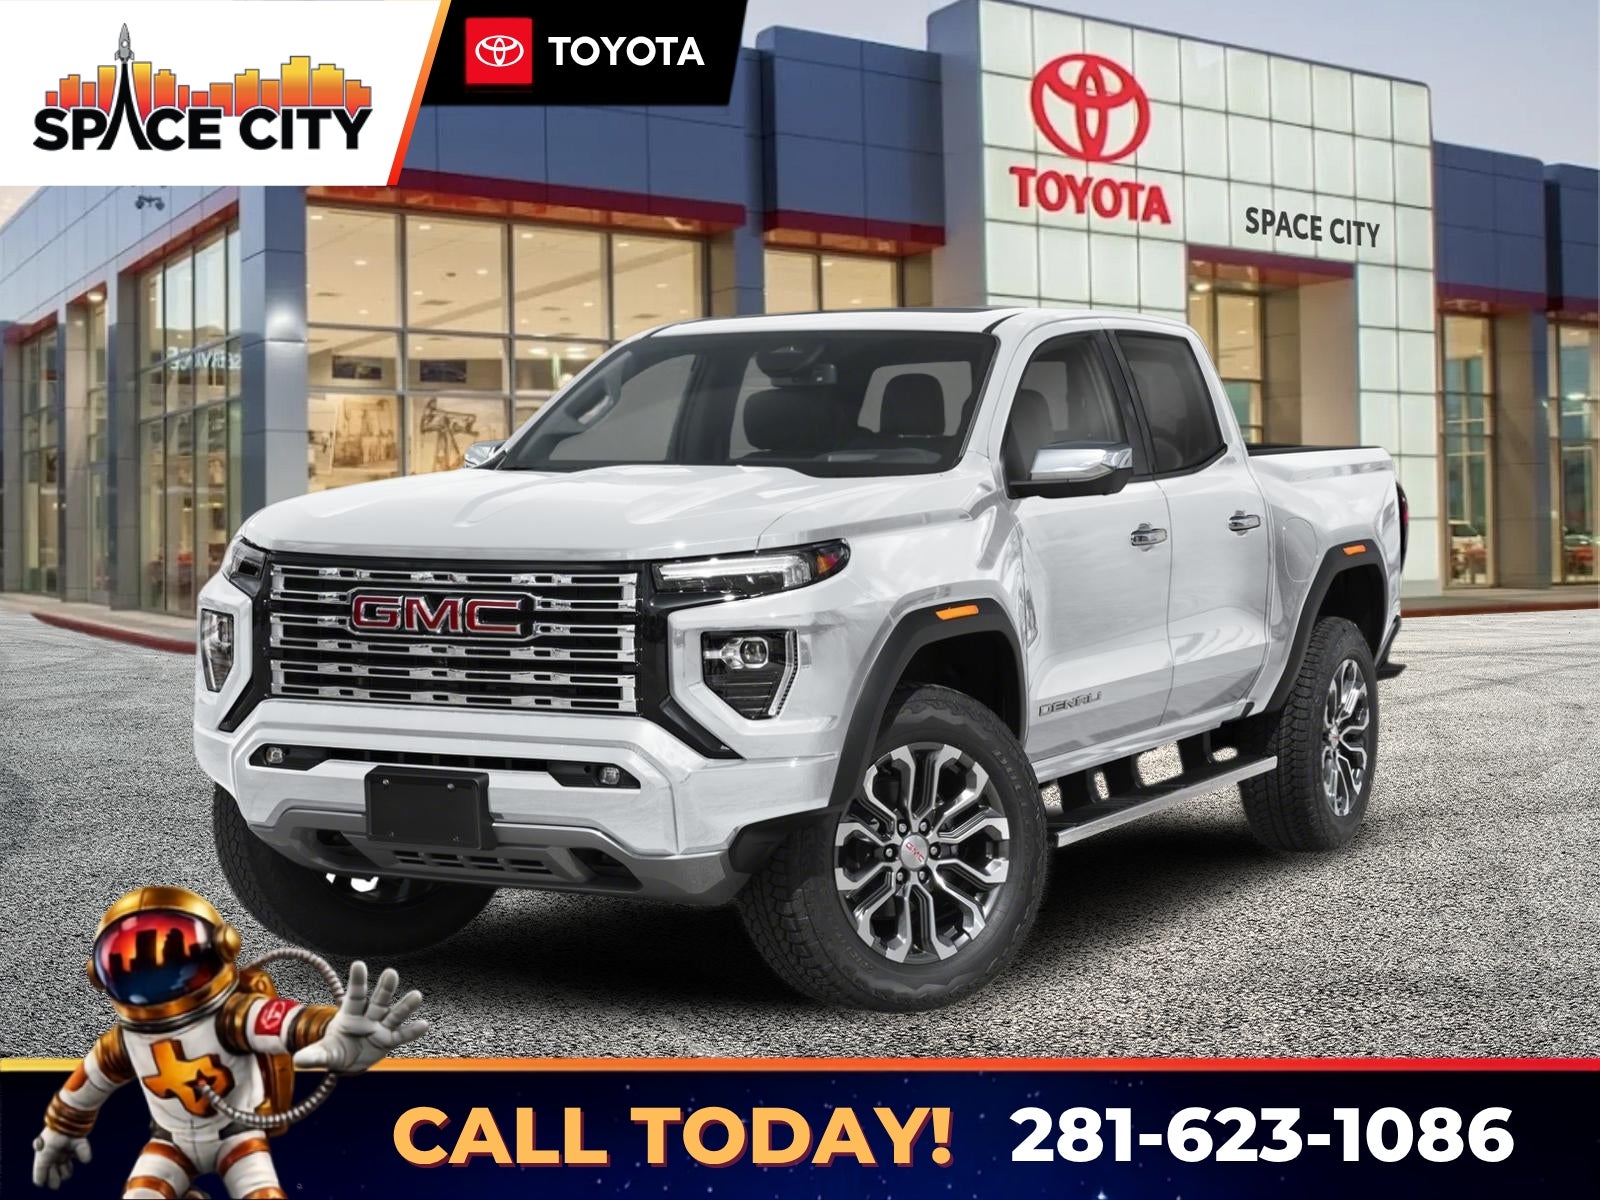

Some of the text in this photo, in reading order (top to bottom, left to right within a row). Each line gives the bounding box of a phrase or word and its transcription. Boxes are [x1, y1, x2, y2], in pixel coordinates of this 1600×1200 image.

[1010, 167, 1171, 223] TOYOTA
[1245, 206, 1381, 248] SPACE CITY
[351, 594, 523, 635] GMC
[1038, 690, 1102, 717] DENALI
